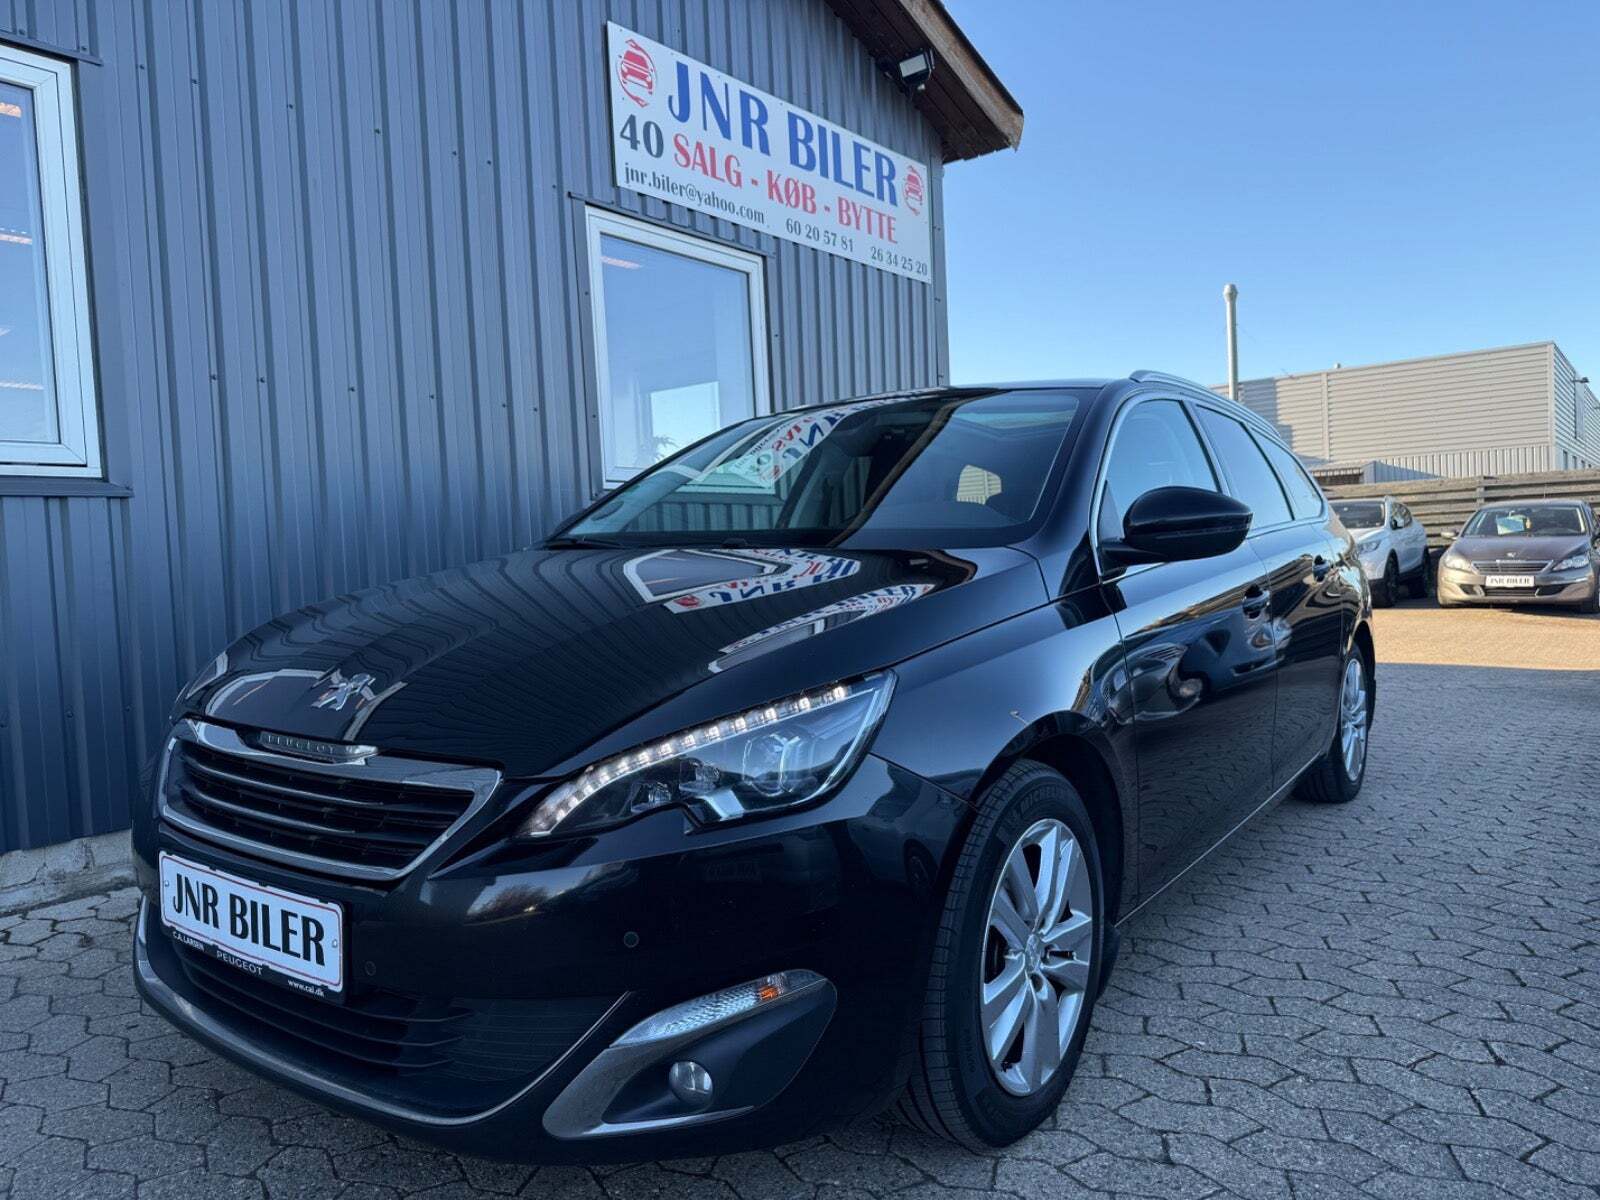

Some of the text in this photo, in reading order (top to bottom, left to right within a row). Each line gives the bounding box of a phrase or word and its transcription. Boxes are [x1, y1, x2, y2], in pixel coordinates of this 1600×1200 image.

[620, 114, 664, 159] 40
[668, 60, 898, 207] JNR BILER
[624, 162, 765, 224] jnr.biler@yahoo.com
[673, 134, 742, 189] SALG
[767, 169, 817, 215] KØB
[838, 196, 898, 244] BYTTE
[786, 218, 854, 252] 60 20 57 81
[870, 246, 928, 276] 26 34 25 20
[172, 873, 326, 967] JNR BILER
[216, 949, 263, 976] PEUGEOT
